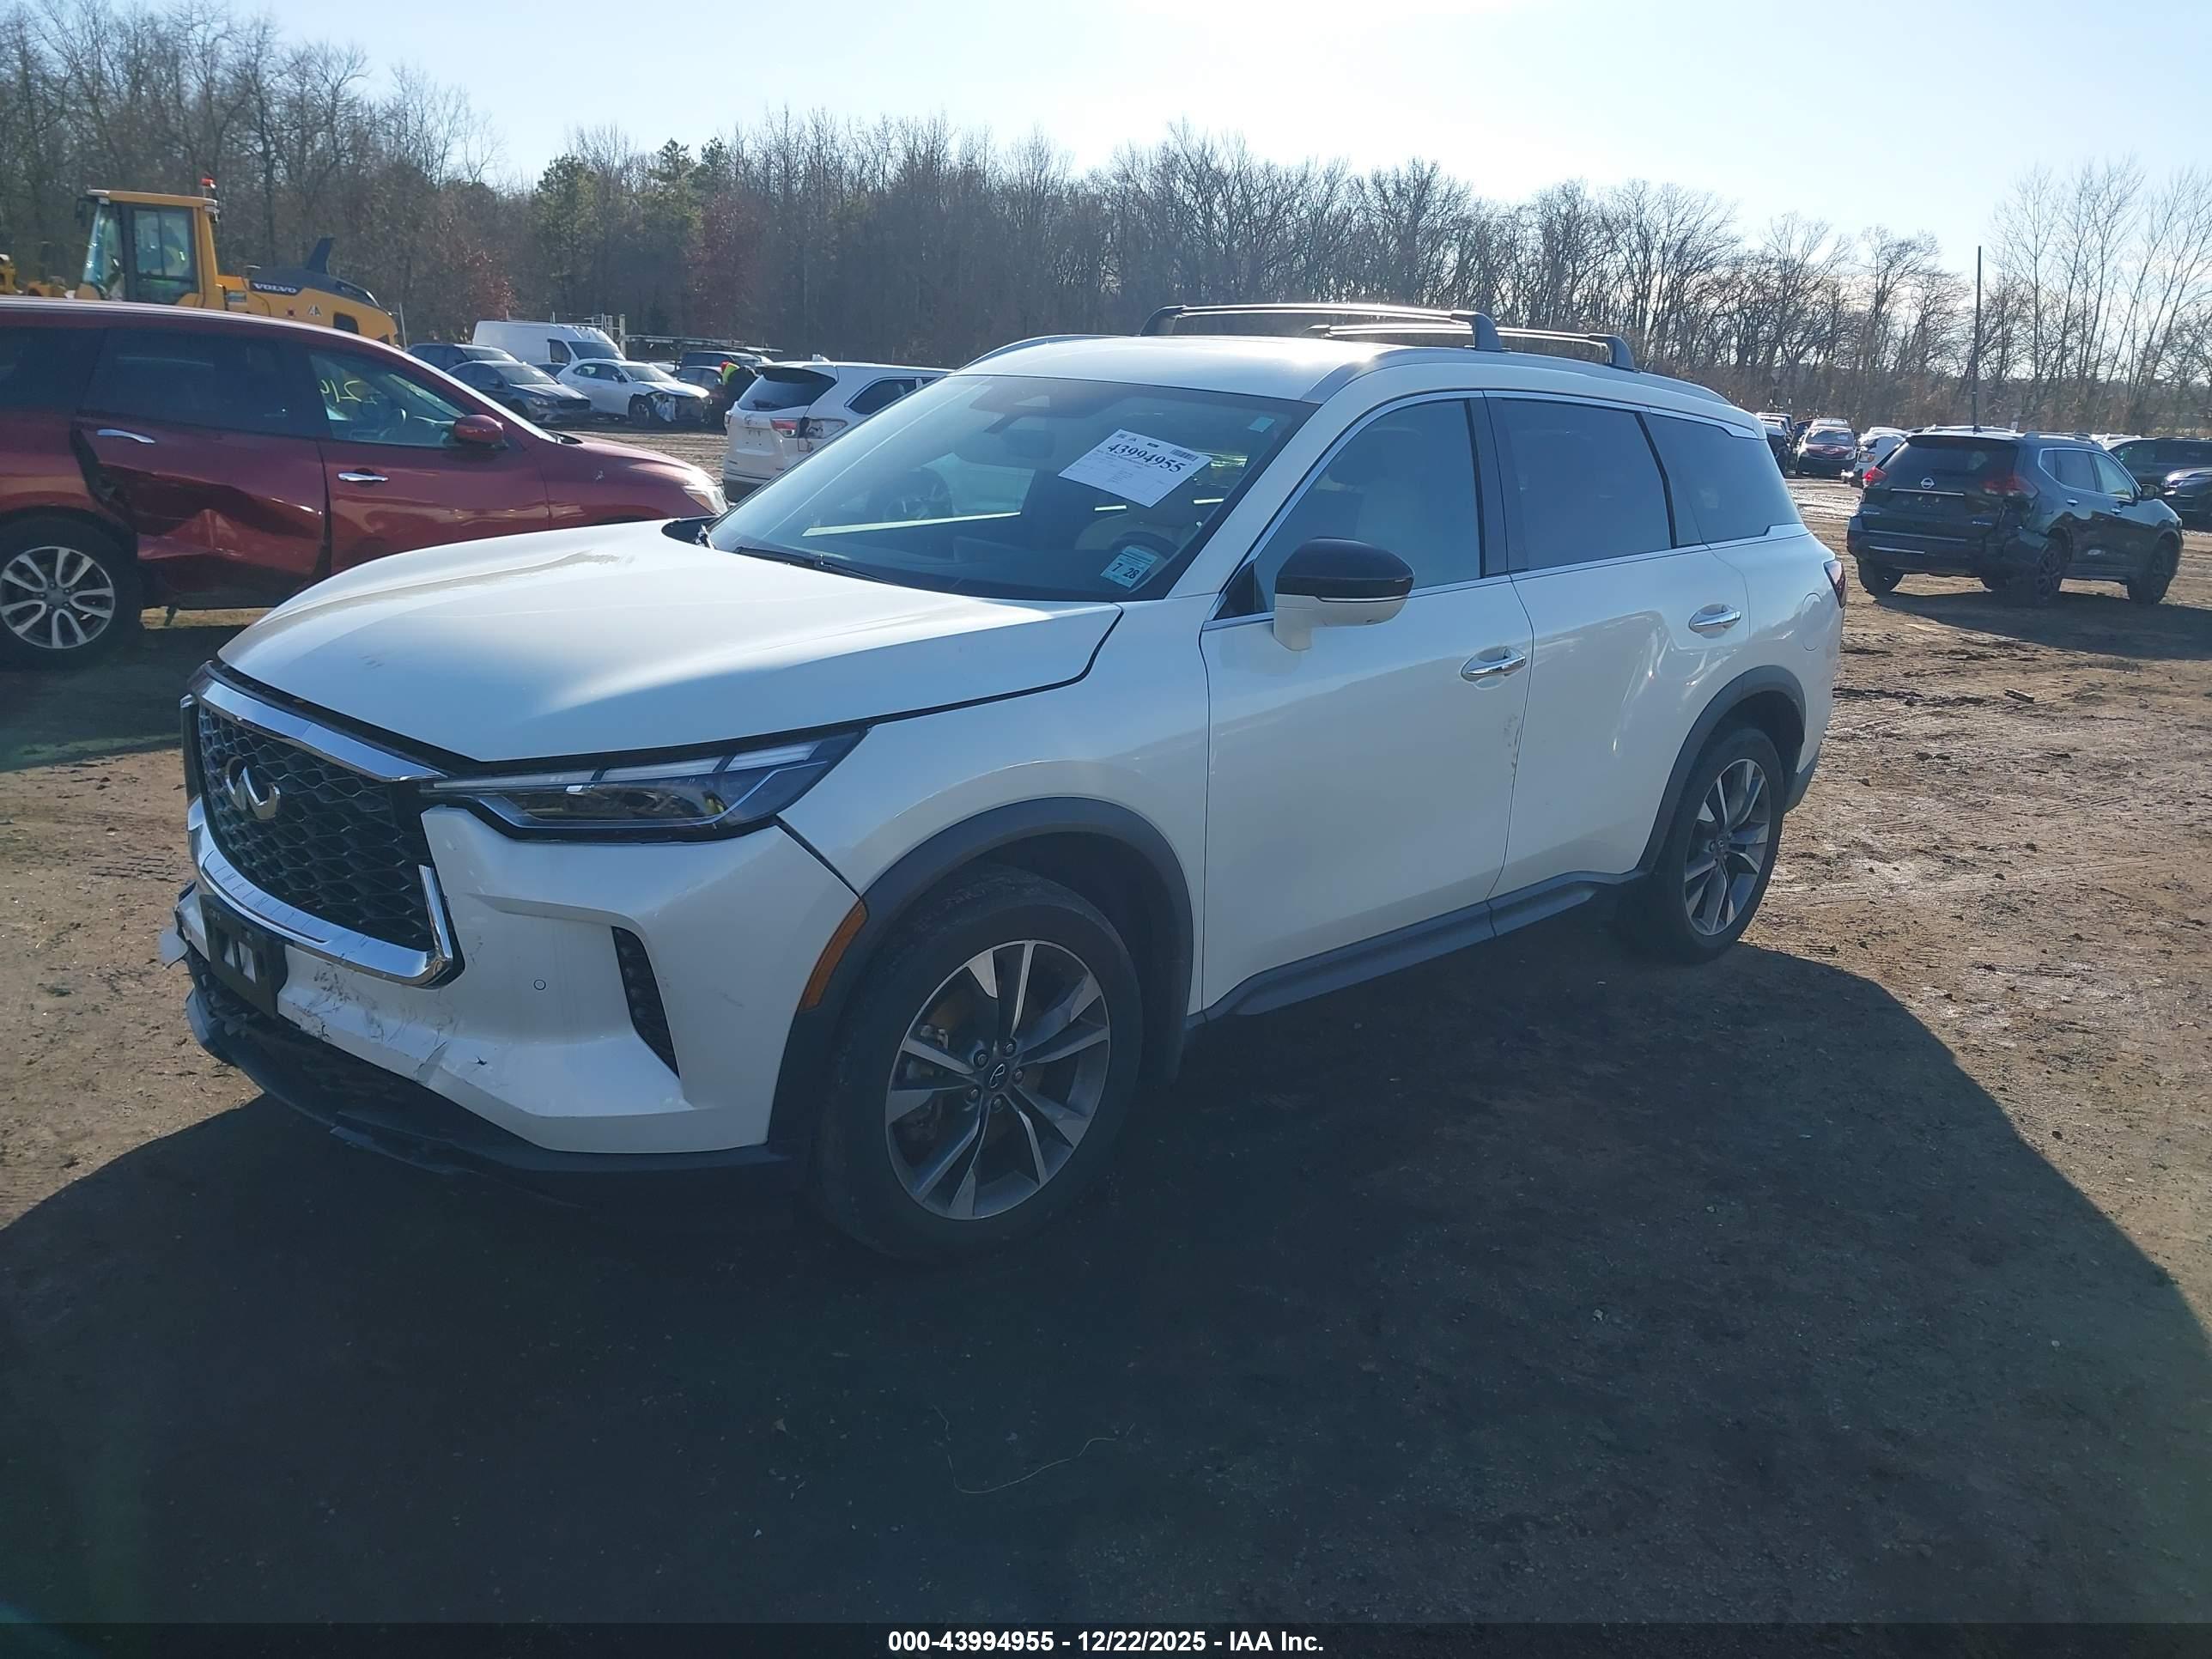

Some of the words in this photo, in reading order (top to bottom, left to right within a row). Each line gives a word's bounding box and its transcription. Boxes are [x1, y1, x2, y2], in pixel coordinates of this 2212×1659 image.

[253, 283, 297, 294] VOLVO
[1107, 443, 1186, 473] 43994955
[1111, 562, 1123, 573] 7
[1122, 568, 1140, 580] 28
